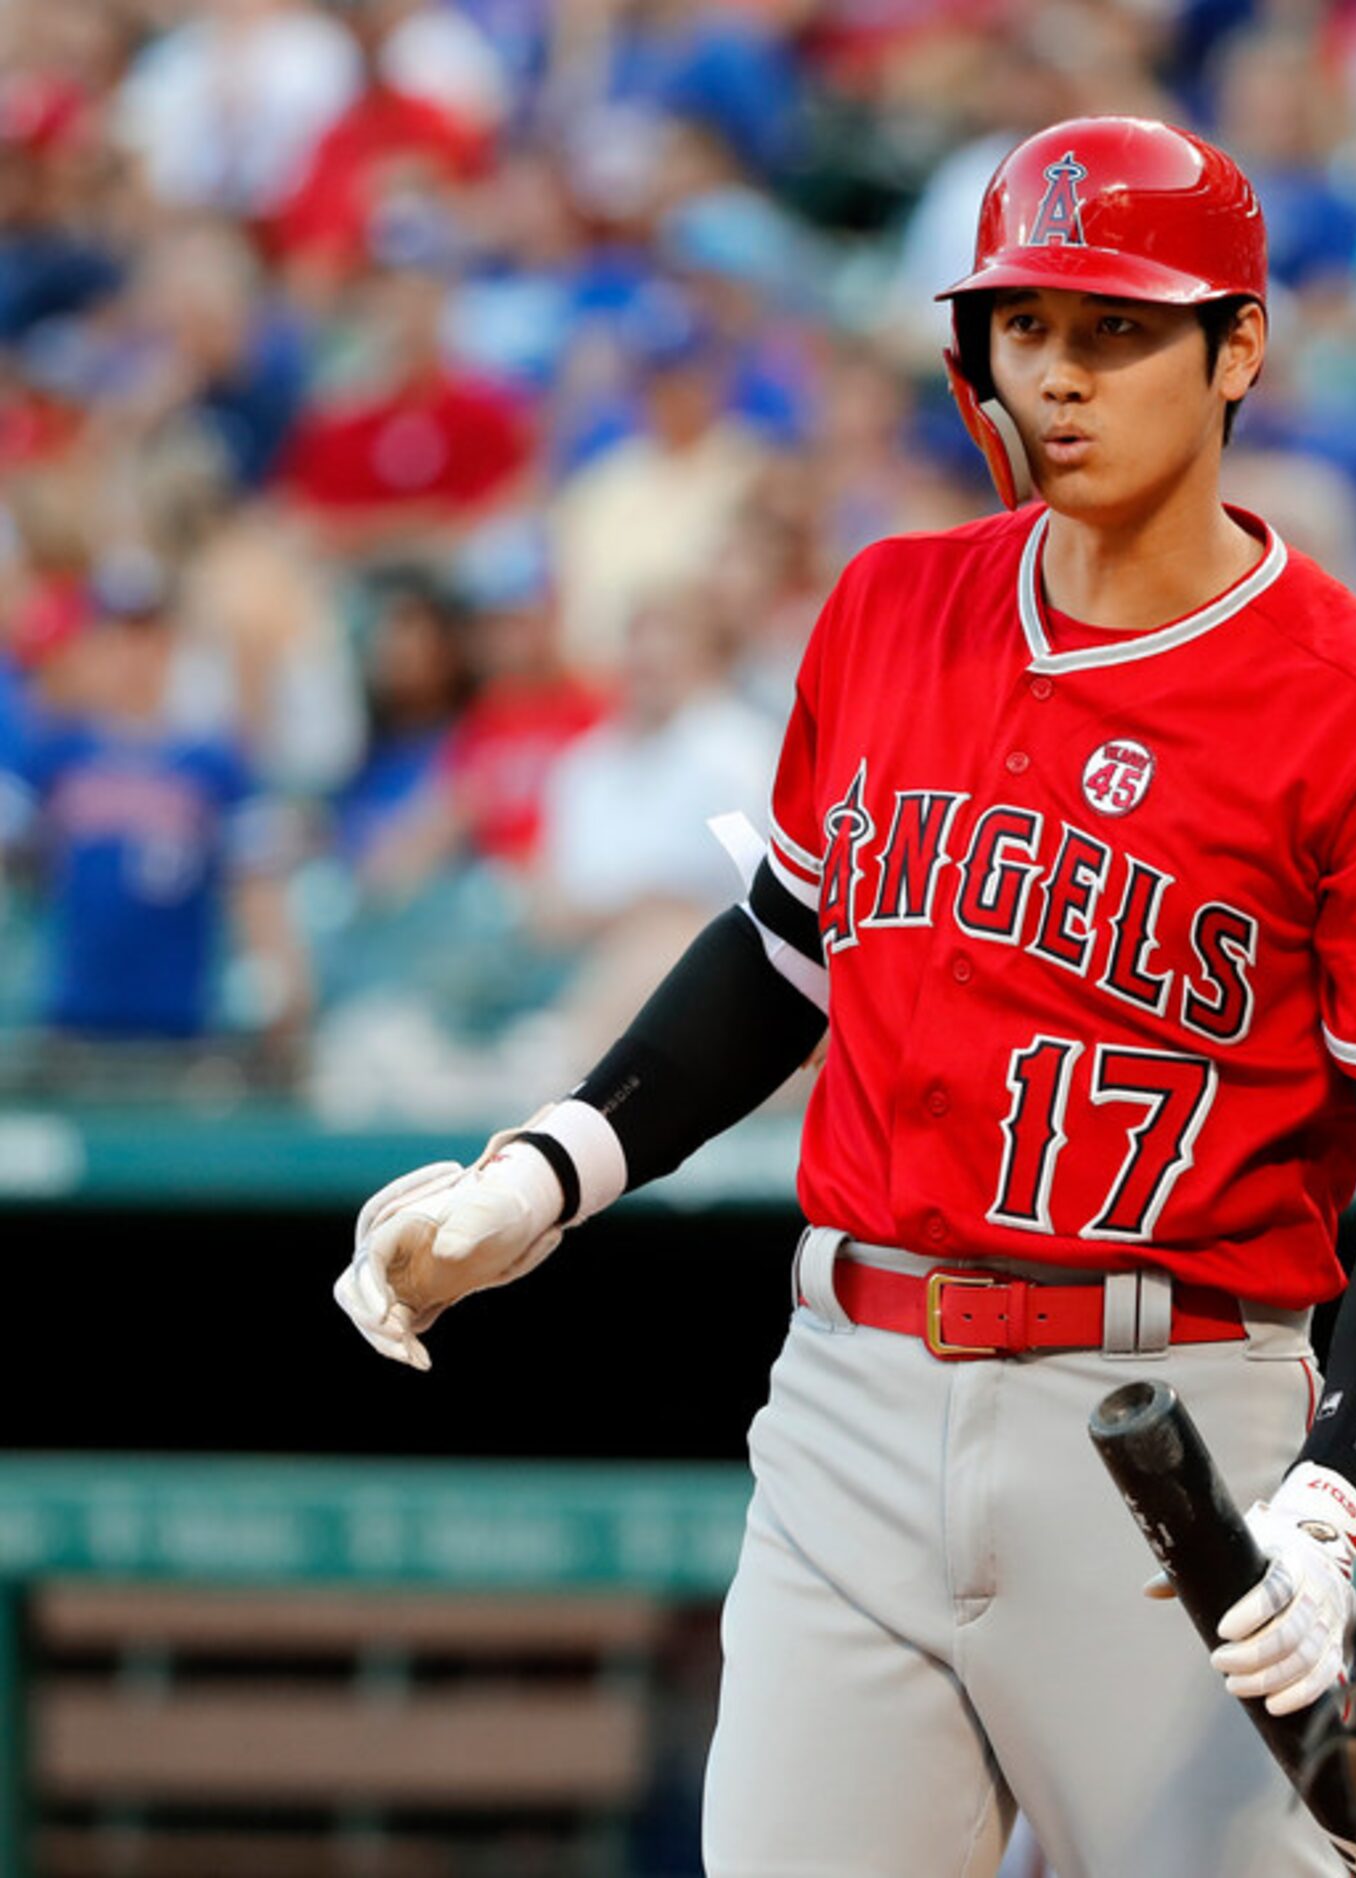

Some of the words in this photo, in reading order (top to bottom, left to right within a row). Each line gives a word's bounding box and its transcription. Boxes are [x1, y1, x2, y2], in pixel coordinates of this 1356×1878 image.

[1086, 762, 1143, 809] 45
[818, 757, 1259, 1045] ANGELS
[986, 1034, 1219, 1243] 17
